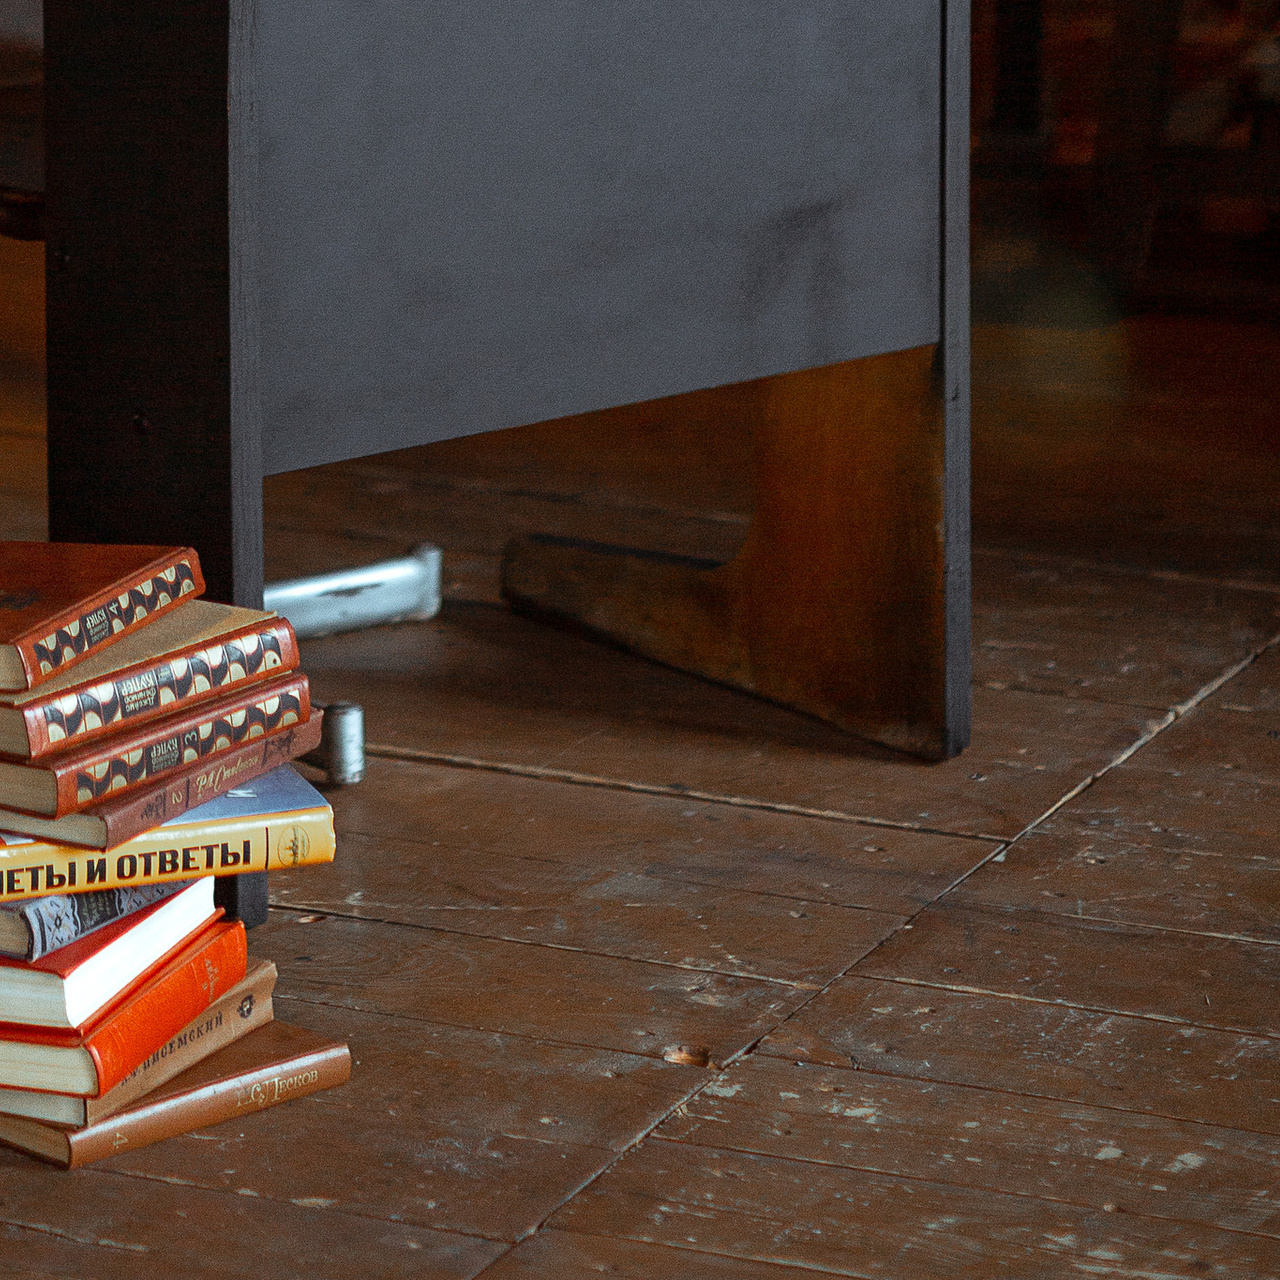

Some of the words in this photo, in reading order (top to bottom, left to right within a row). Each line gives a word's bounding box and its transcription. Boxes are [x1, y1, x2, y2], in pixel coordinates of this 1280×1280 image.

[109, 602, 119, 615] 4
[121, 673, 155, 696] КУПЕР
[150, 737, 178, 758] КУПЕР
[184, 731, 198, 745] 3
[86, 858, 107, 884] И
[116, 840, 250, 880] ОТВЕТЫ
